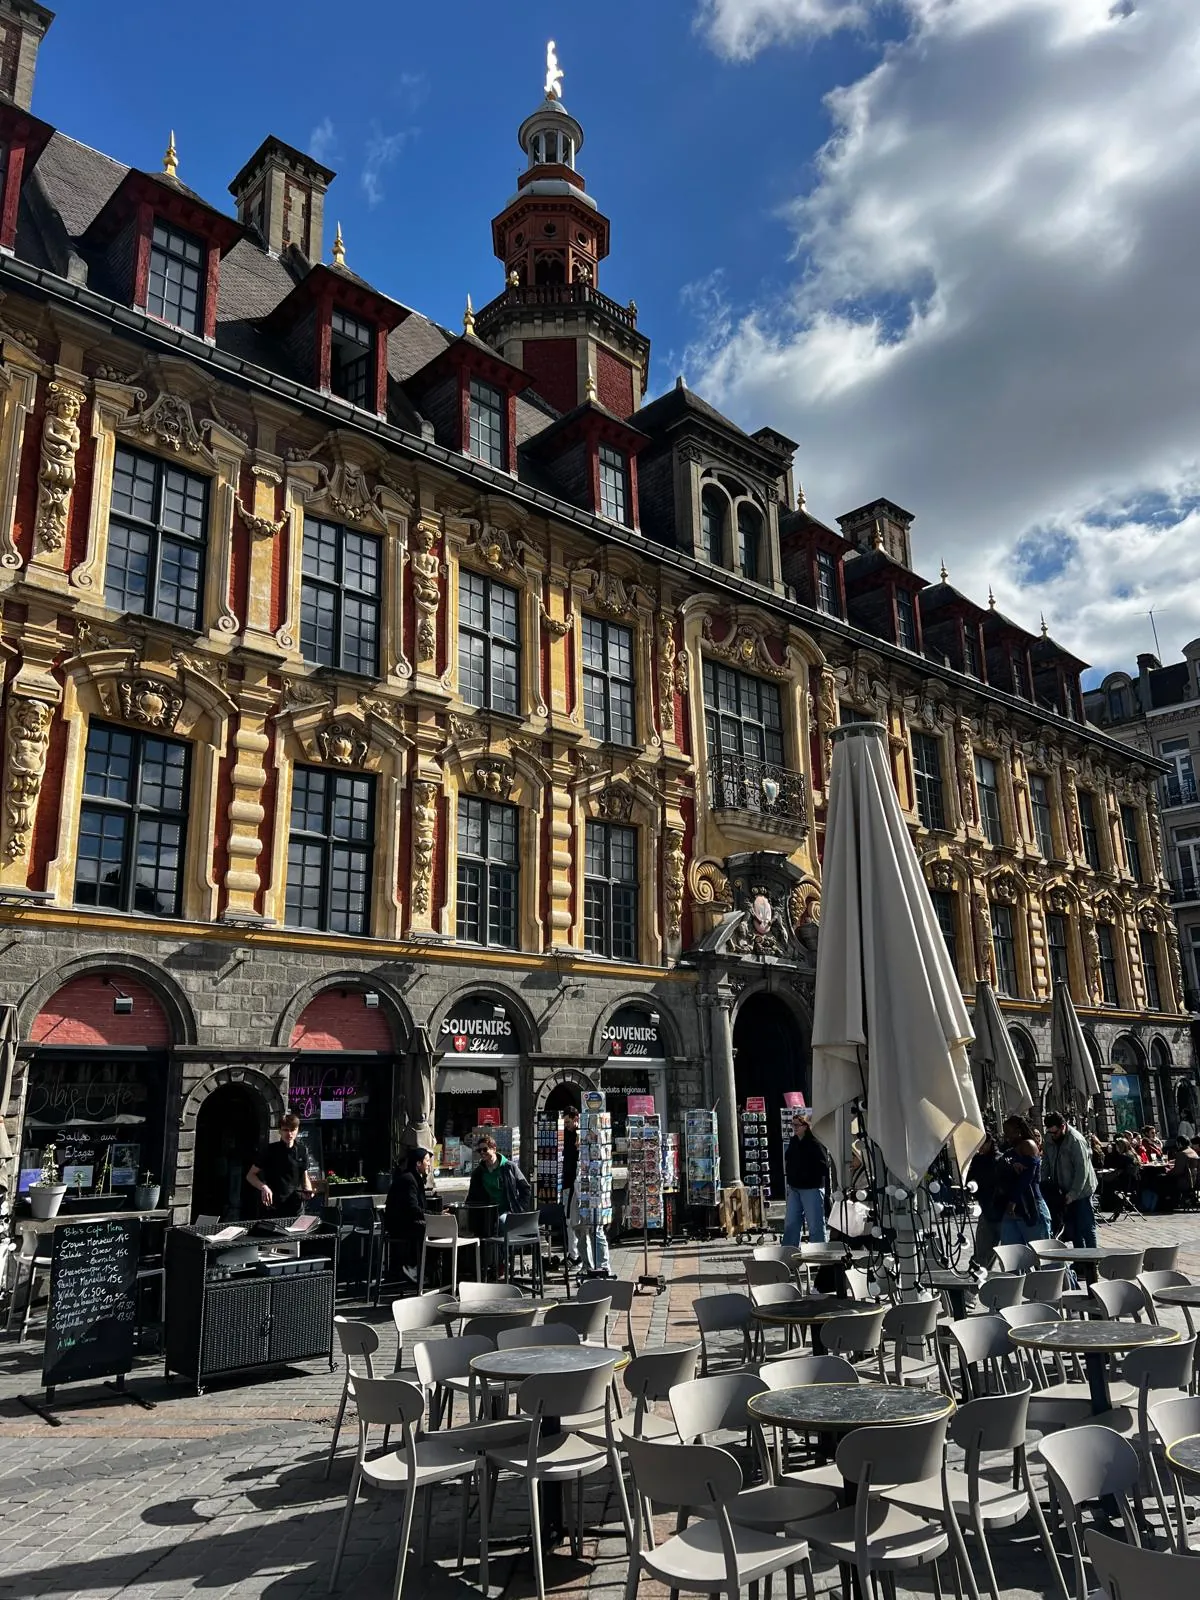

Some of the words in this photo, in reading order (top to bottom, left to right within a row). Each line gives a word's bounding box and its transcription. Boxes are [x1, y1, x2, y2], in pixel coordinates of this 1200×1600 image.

[441, 1018, 511, 1036] SOUVENIRS
[602, 1026, 657, 1041] SOUVENIRS
[469, 1037, 499, 1051] Lille
[624, 1043, 648, 1055] Lille
[450, 1086, 483, 1095] Souvenirs
[61, 1240, 86, 1251] Croque
